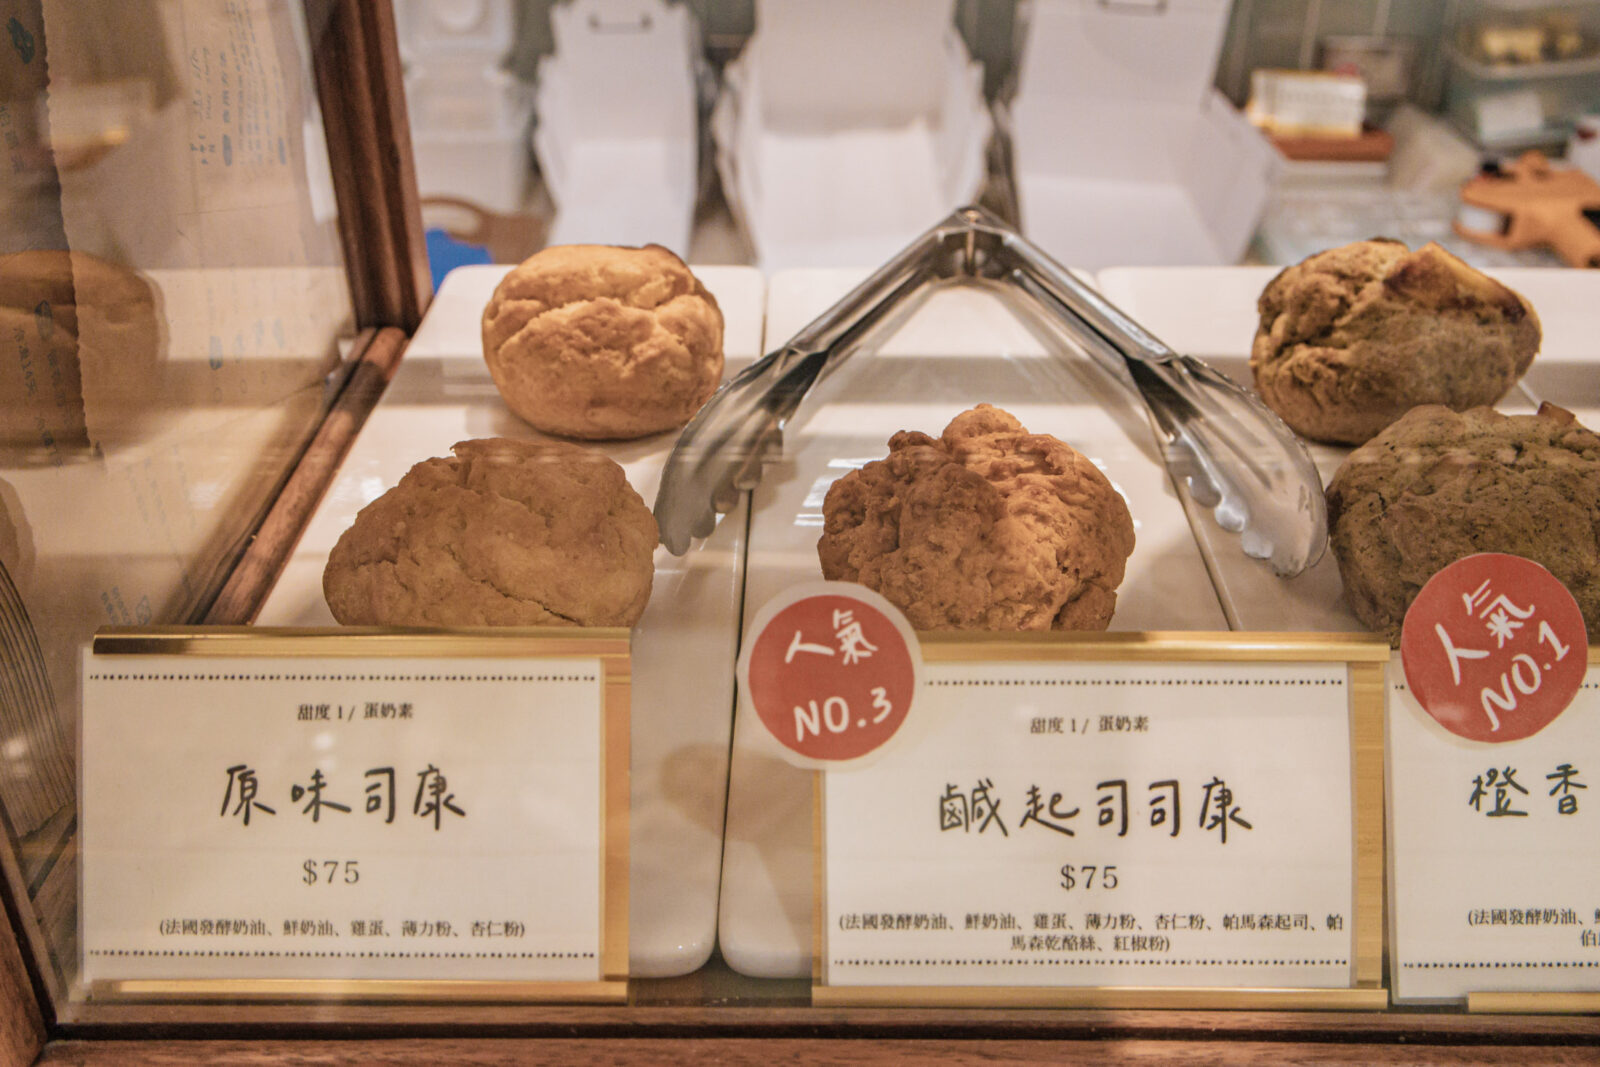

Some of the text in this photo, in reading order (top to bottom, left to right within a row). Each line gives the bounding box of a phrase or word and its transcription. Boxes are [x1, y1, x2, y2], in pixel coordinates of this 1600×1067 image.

[785, 608, 878, 665] 人氣
[1435, 579, 1535, 686] 人氣
[1480, 620, 1570, 731] NO.1
[297, 703, 331, 721] 甜度
[363, 701, 414, 720] 蛋奶素
[1030, 717, 1064, 734] 甜度
[1099, 715, 1149, 733] 蛋奶素
[220, 764, 467, 831] 原味司康
[938, 777, 1254, 845] 鹹起司司康
[1468, 763, 1588, 818] 橙香
[302, 860, 361, 886] $75
[1060, 865, 1119, 891] $75
